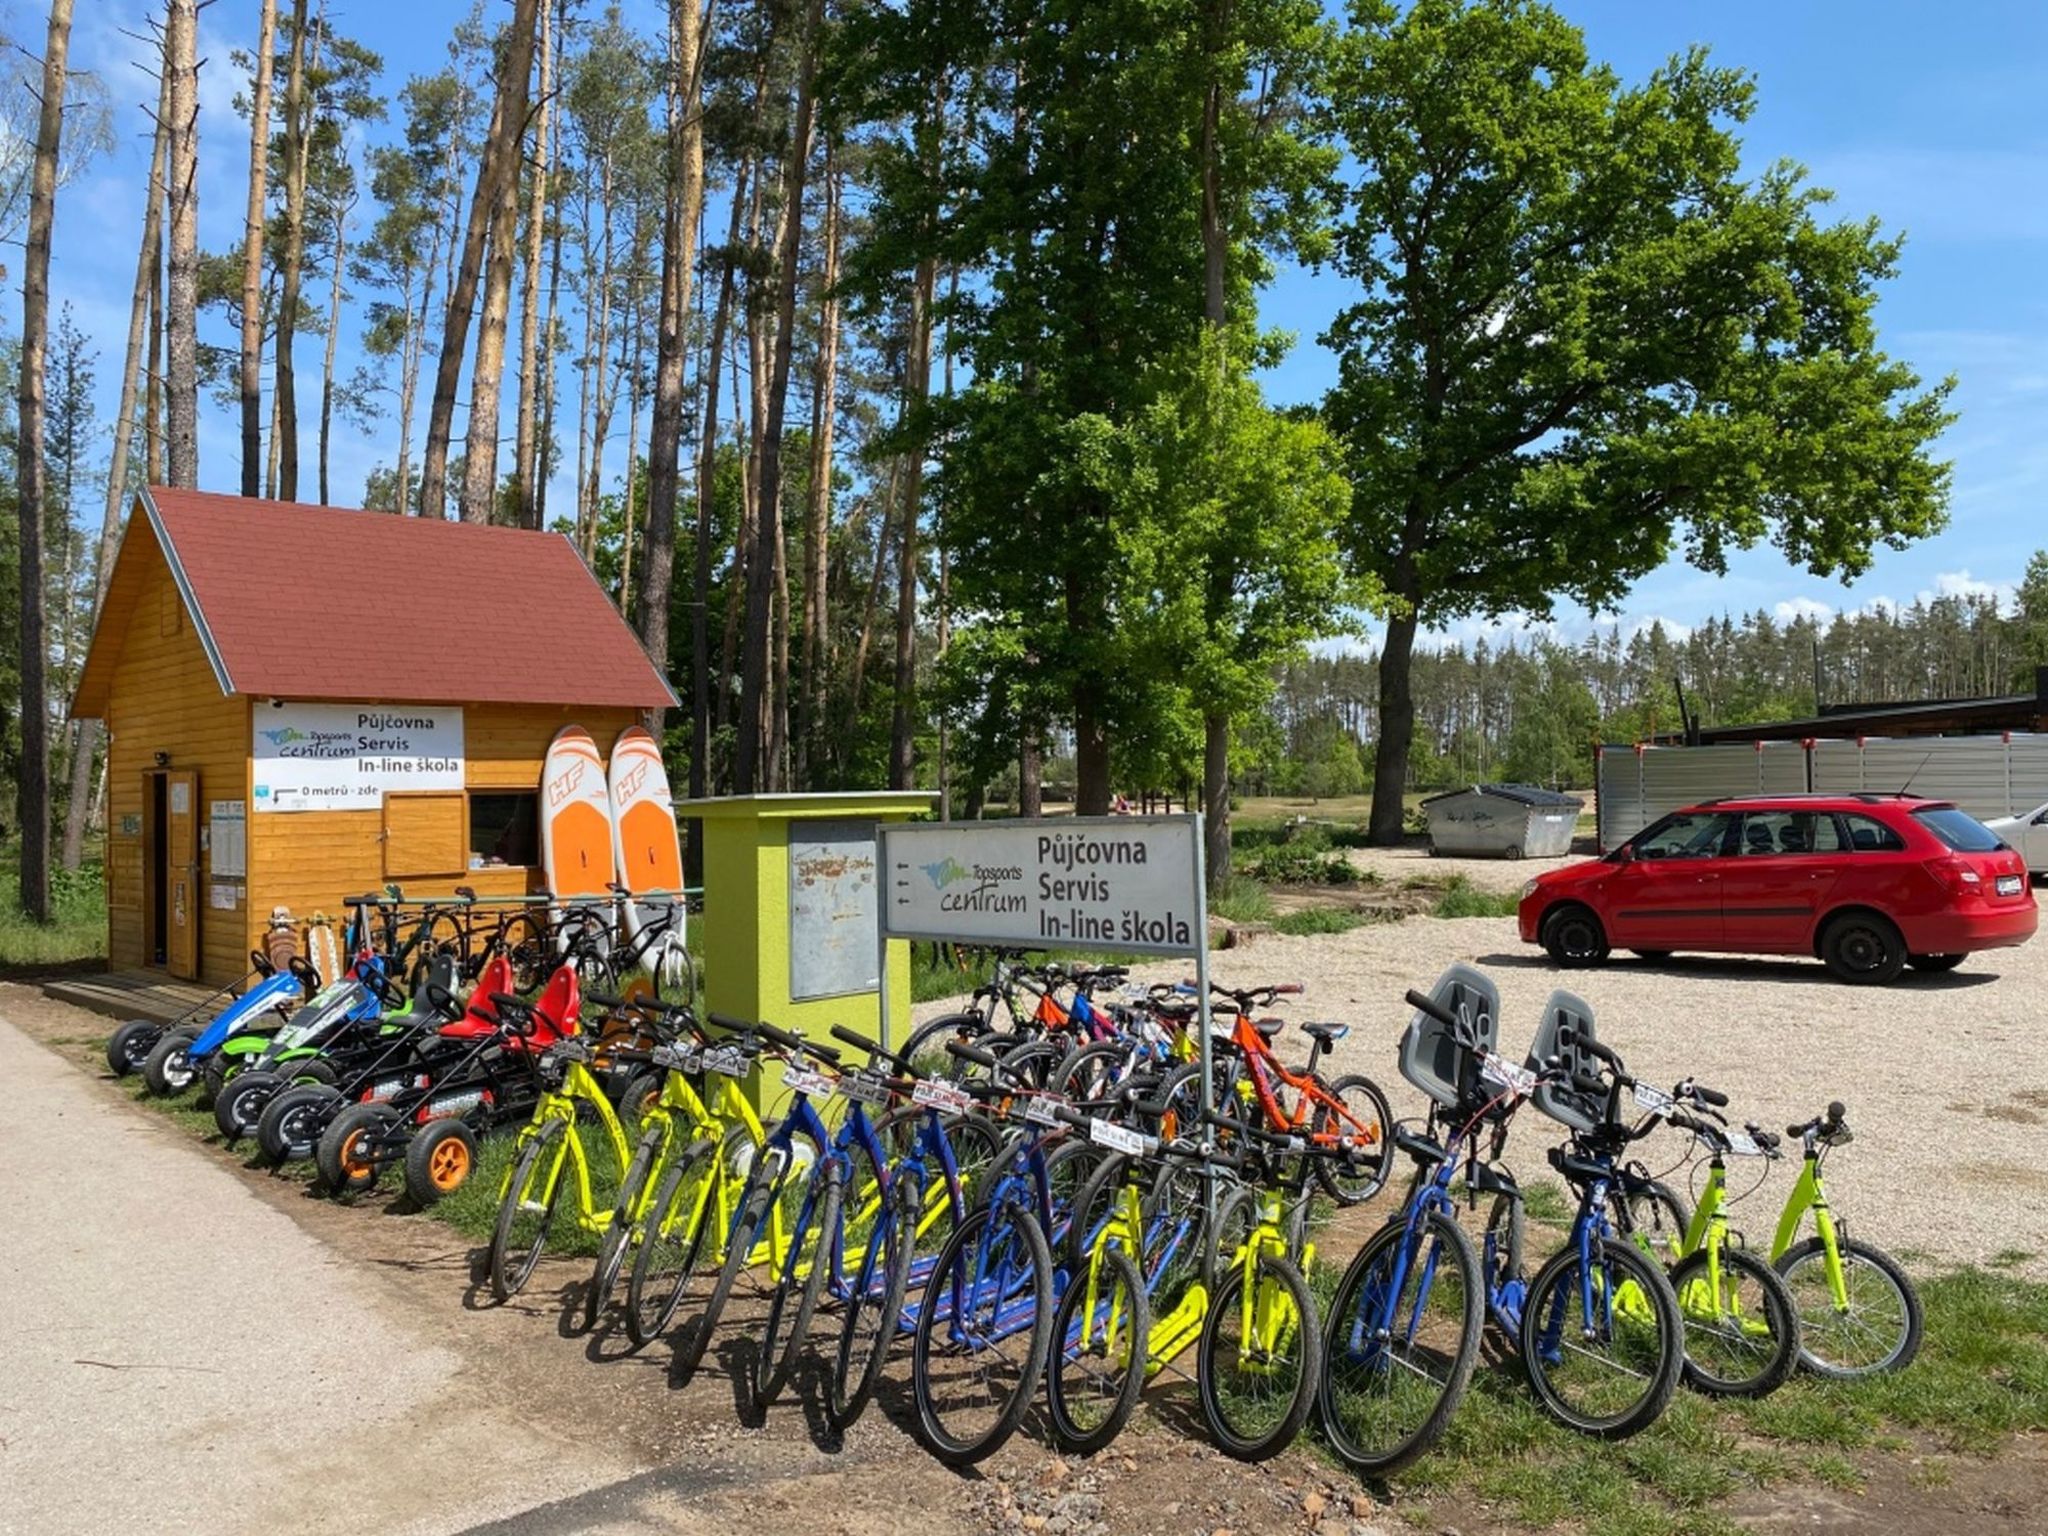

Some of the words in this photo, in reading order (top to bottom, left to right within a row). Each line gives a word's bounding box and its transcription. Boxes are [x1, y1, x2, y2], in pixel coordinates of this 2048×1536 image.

[357, 713, 435, 732] Půjčovna
[357, 736, 410, 751] Servis
[358, 757, 412, 772] In-line
[417, 757, 459, 772] škola
[312, 784, 349, 796] metrů
[357, 785, 379, 796] zde
[1037, 834, 1148, 873] Půjčovna
[972, 864, 1023, 884] Topsports
[1038, 872, 1110, 902] Servis
[940, 881, 1027, 914] centrum
[1039, 908, 1115, 940] In-line
[1121, 910, 1191, 945] škola
